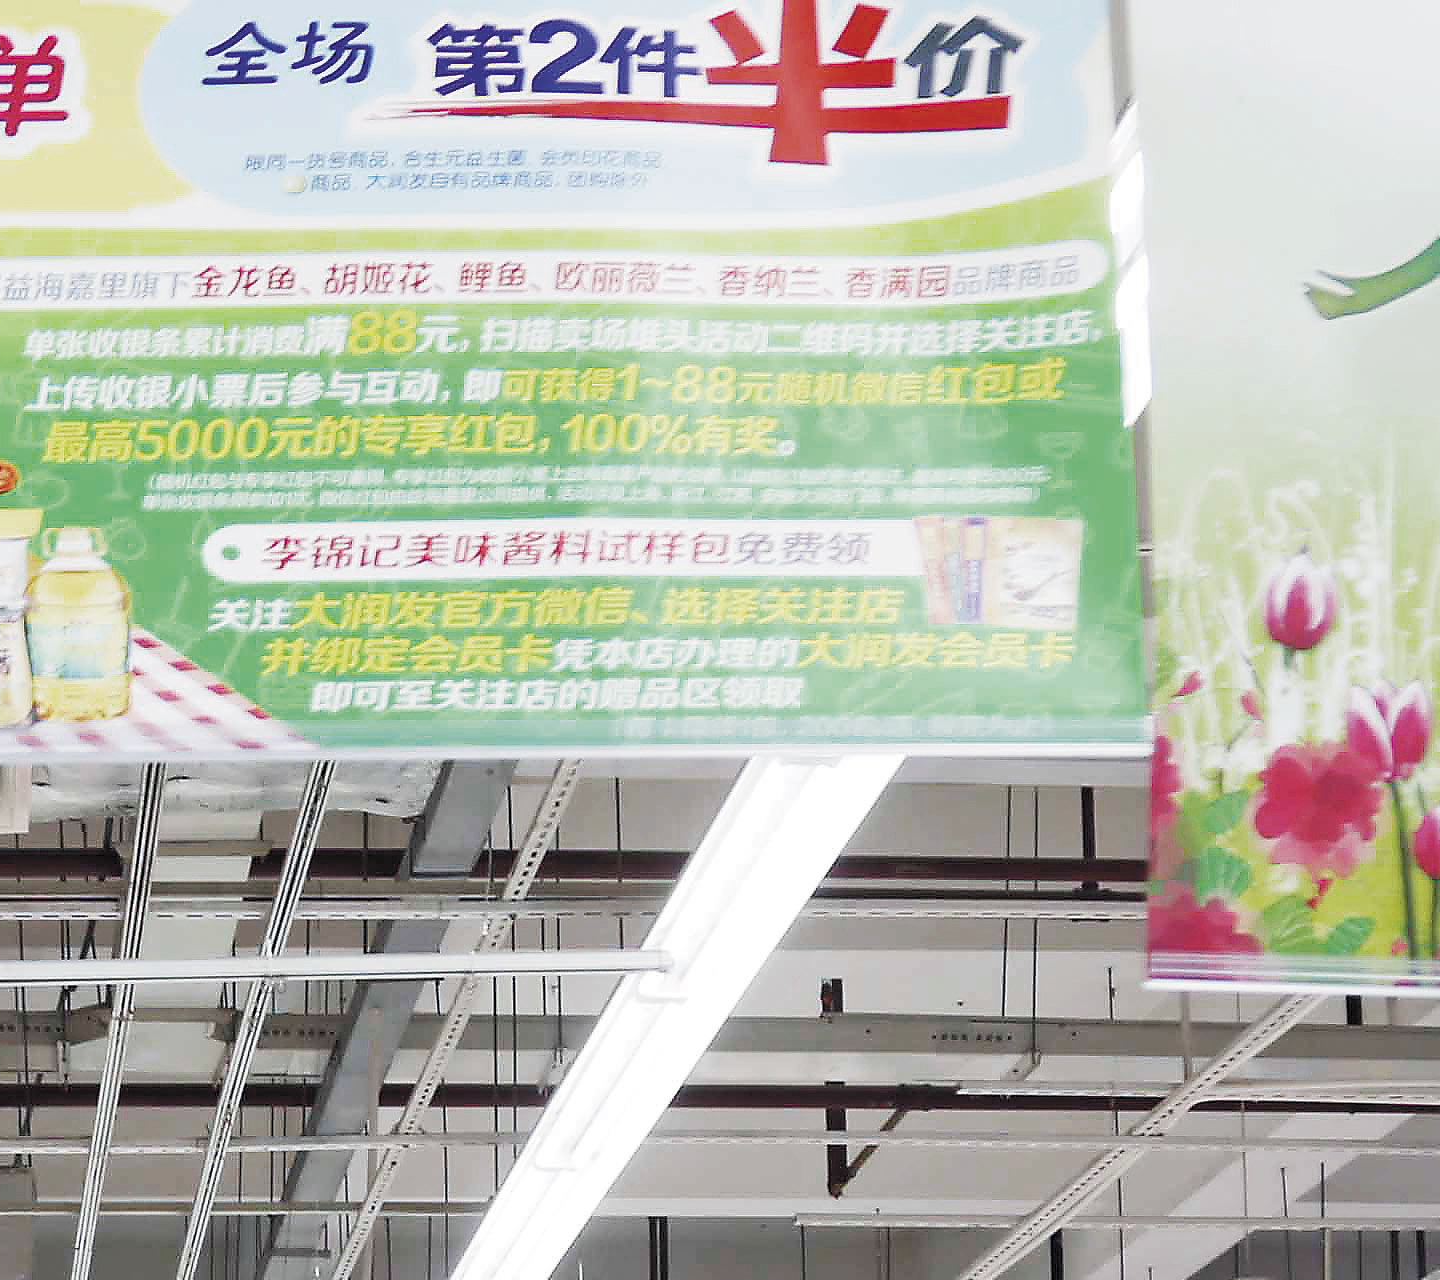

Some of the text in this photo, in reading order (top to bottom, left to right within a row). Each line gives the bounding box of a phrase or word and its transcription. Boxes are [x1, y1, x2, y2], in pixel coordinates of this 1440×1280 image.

[202, 0, 1026, 166] 全场 第2件半价
